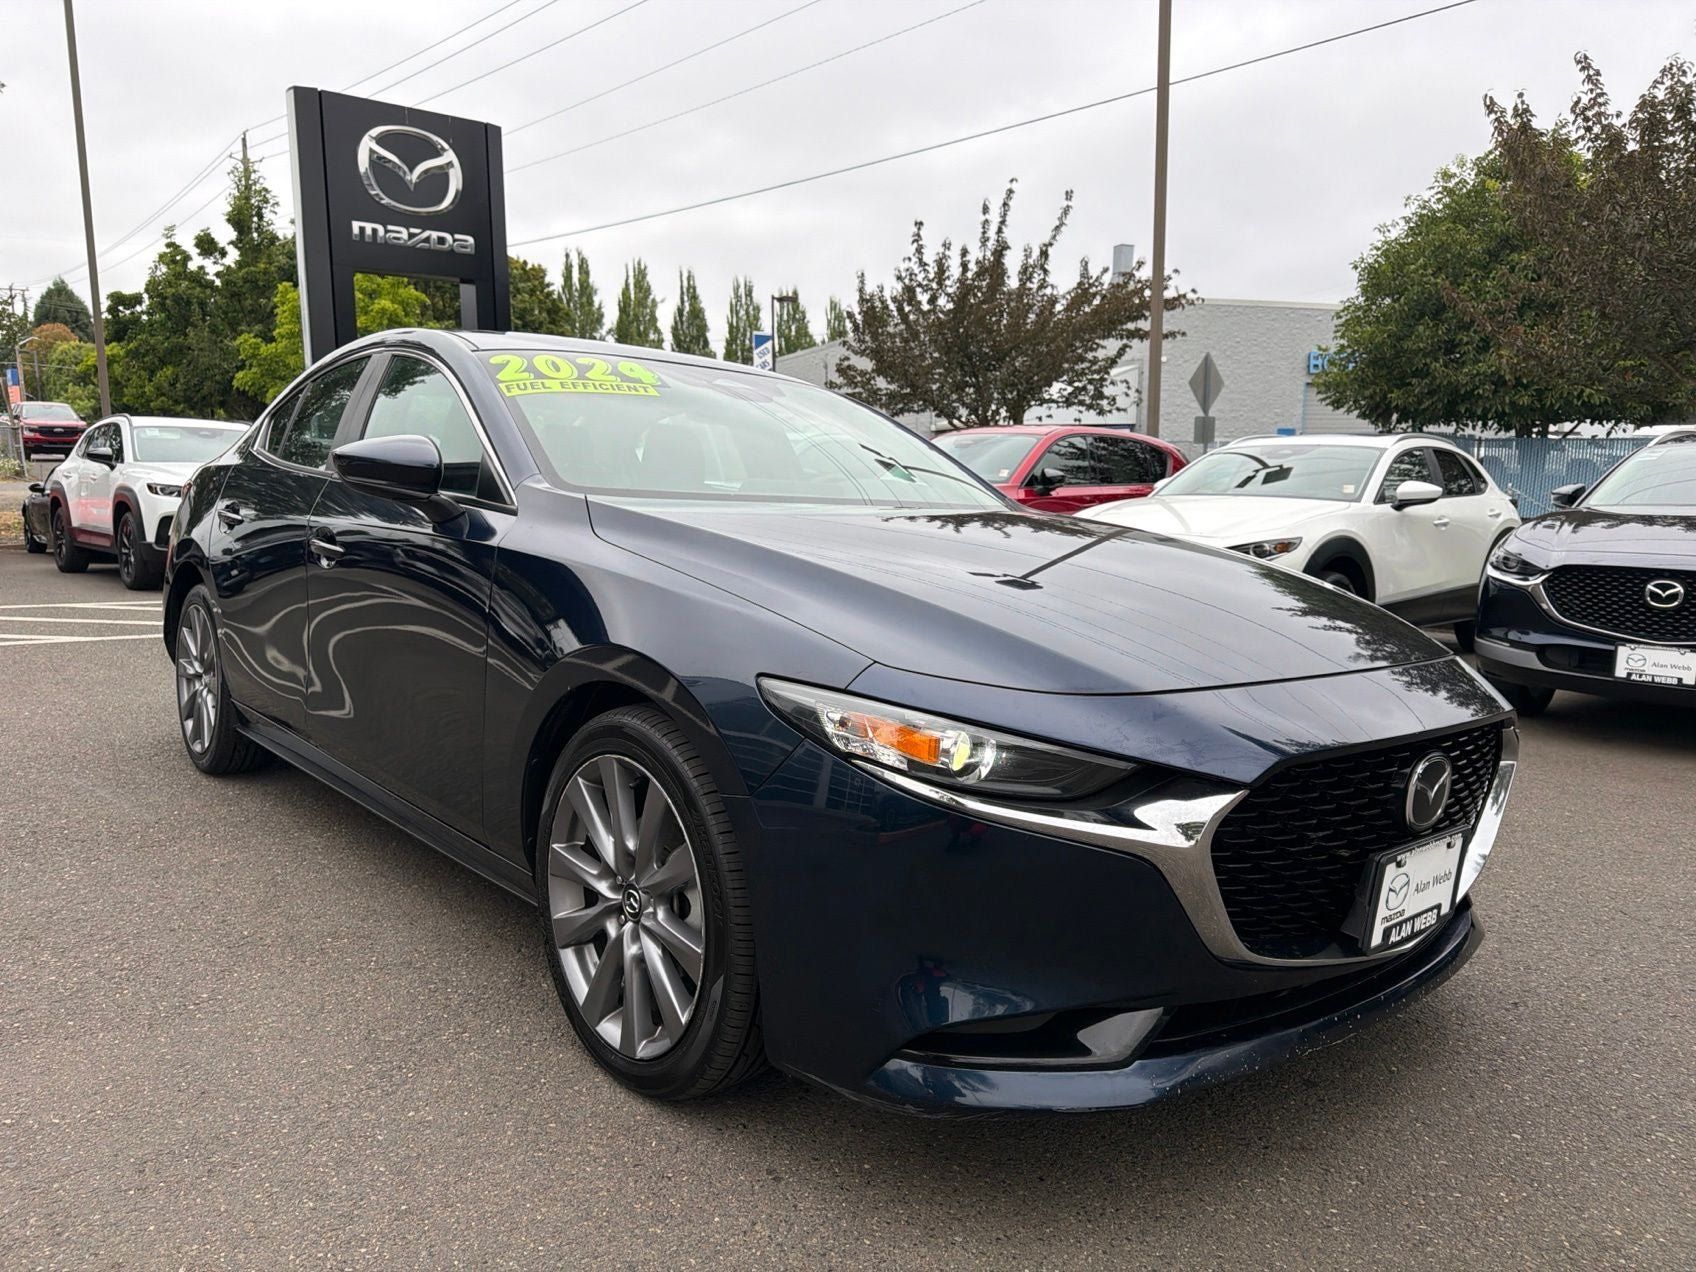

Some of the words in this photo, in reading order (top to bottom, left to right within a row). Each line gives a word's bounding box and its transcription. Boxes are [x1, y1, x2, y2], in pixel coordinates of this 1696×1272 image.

[352, 220, 475, 255] mazda
[489, 354, 661, 385] 2024
[504, 382, 549, 393] FUEL
[560, 381, 650, 394] EFFICIENT
[1651, 661, 1669, 669] Alan
[1670, 664, 1693, 672] Webb
[1631, 674, 1653, 682] ALAN
[1654, 676, 1678, 685] WEBB
[1413, 879, 1431, 896] Alan
[1432, 869, 1453, 887] Webb
[1381, 908, 1406, 926] mazda
[1389, 920, 1413, 945] ALAN
[1414, 909, 1438, 932] WEBB
